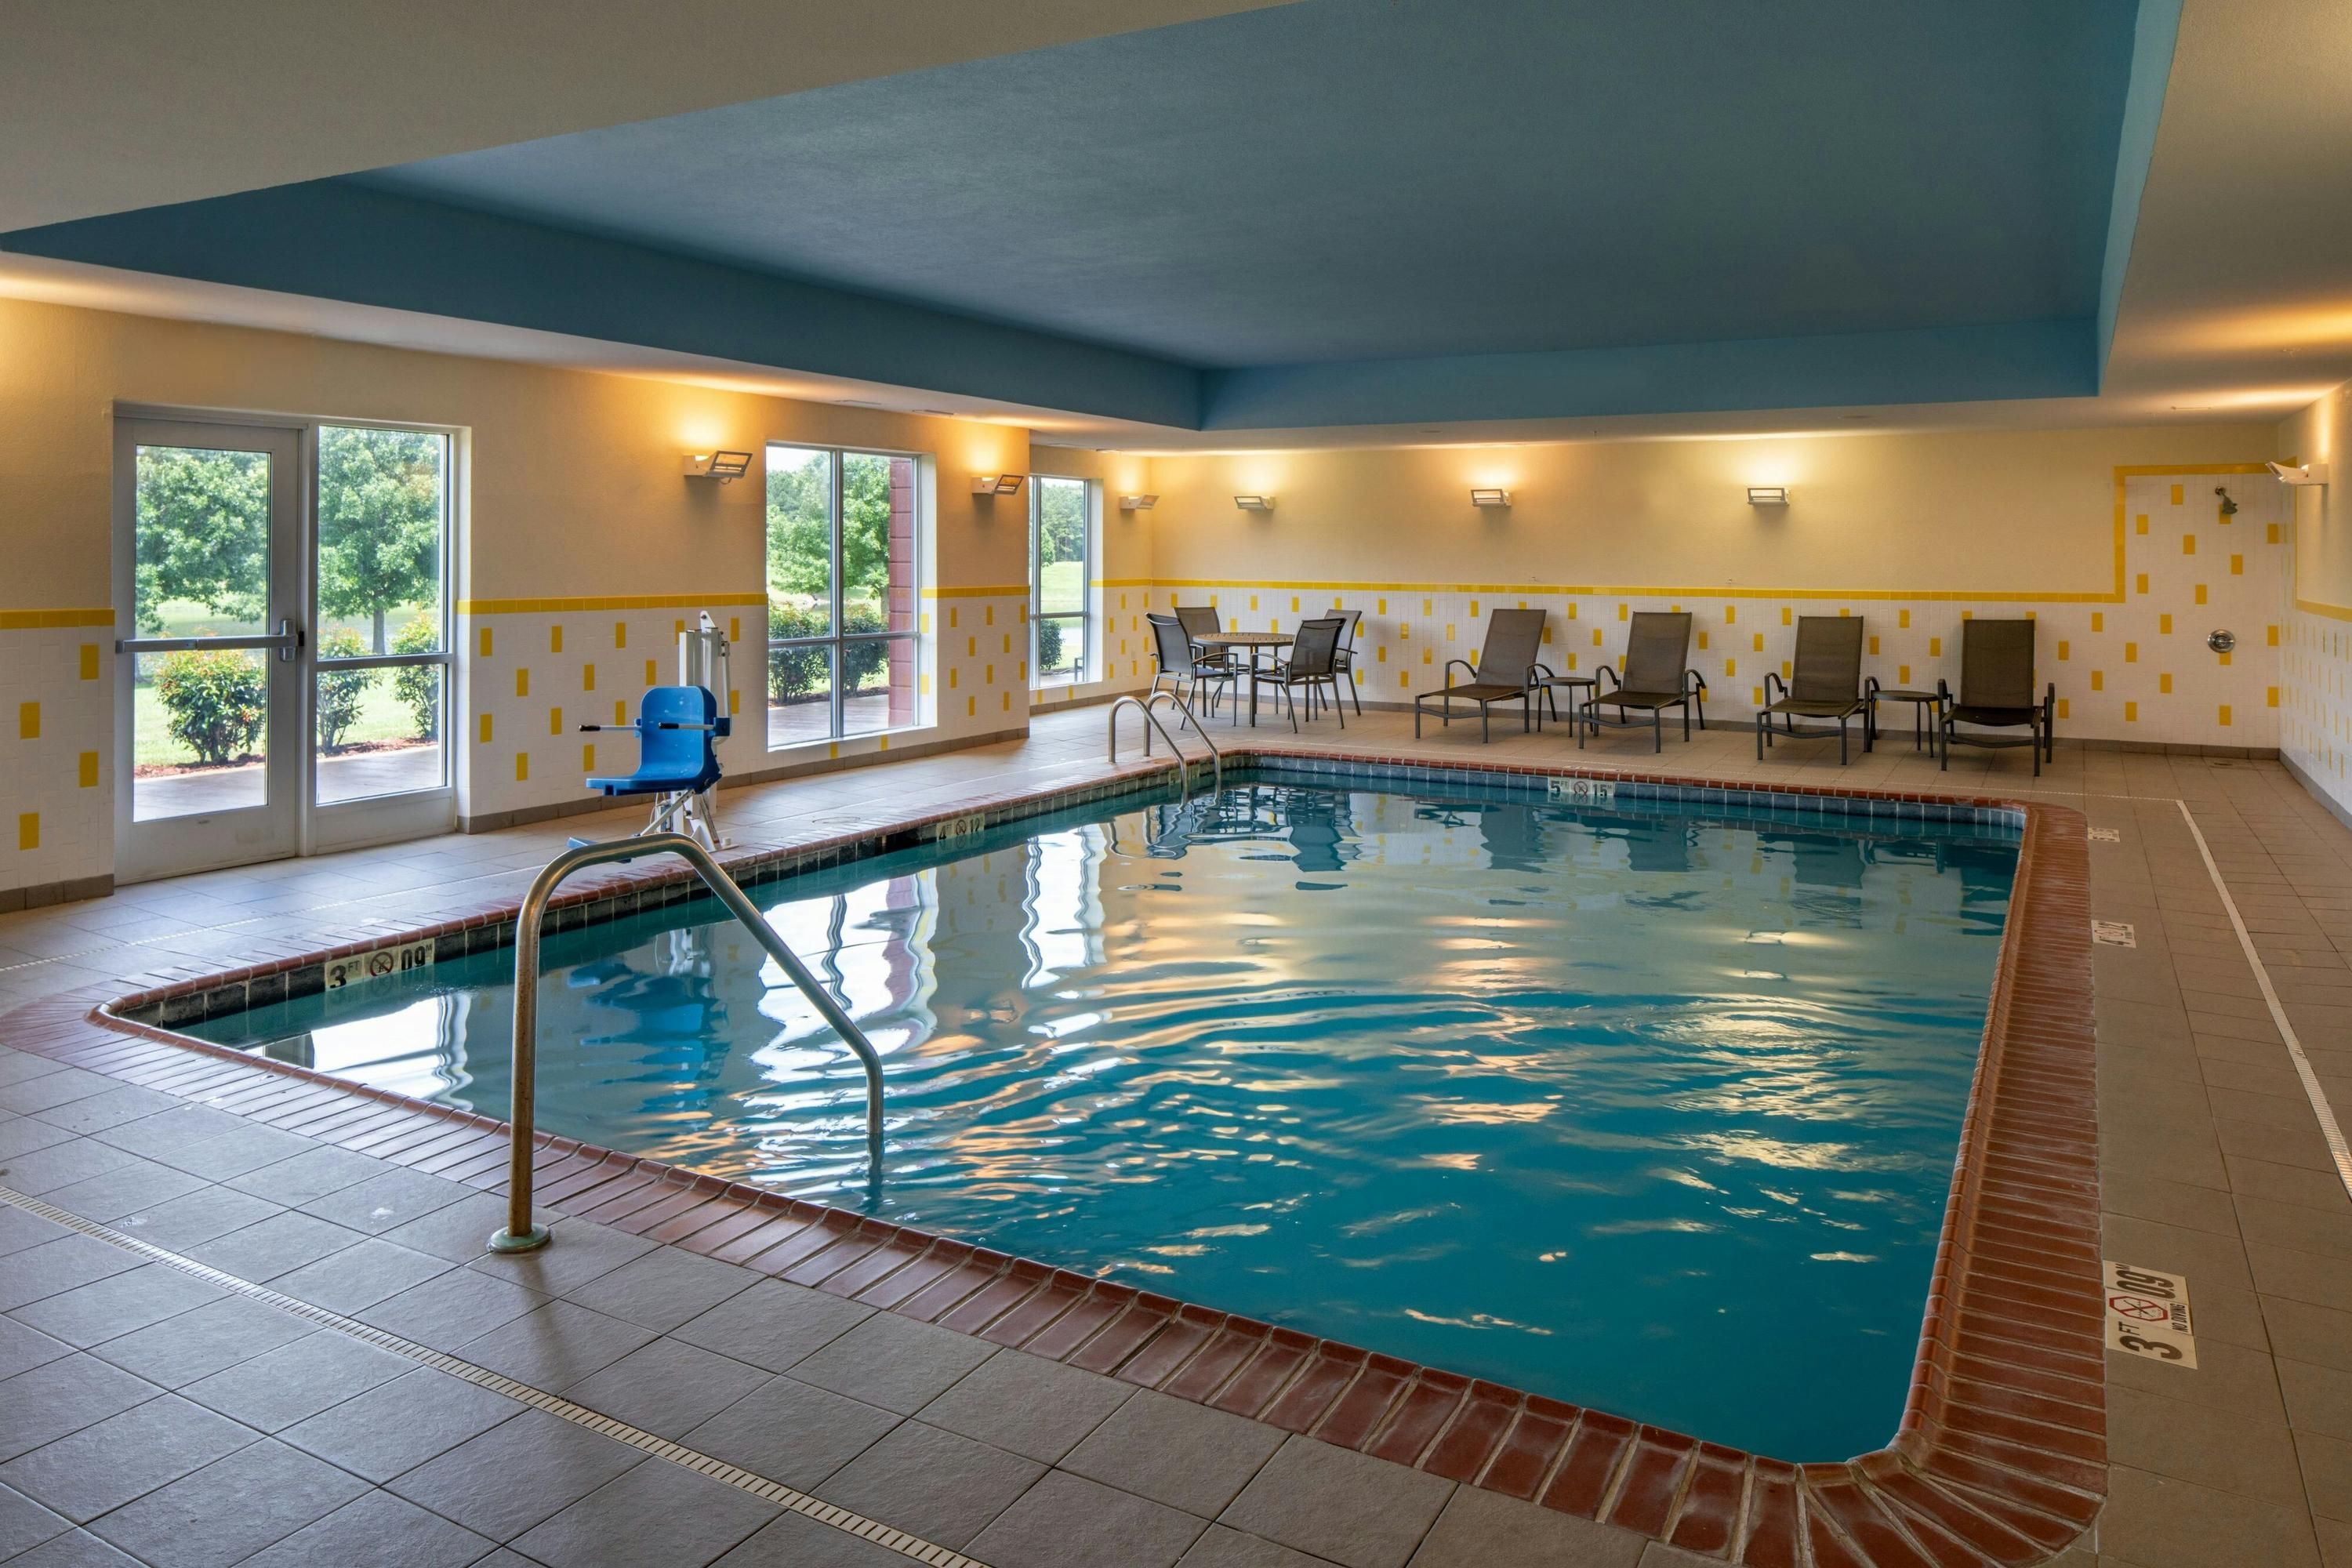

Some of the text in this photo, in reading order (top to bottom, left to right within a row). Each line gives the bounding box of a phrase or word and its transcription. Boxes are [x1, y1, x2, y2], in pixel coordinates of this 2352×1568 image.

[1551, 781, 1561, 792] 5
[329, 960, 361, 989] 3 FT
[2169, 1303, 2189, 1333] NO DIVING
[2118, 1321, 2183, 1360] 3 FT
